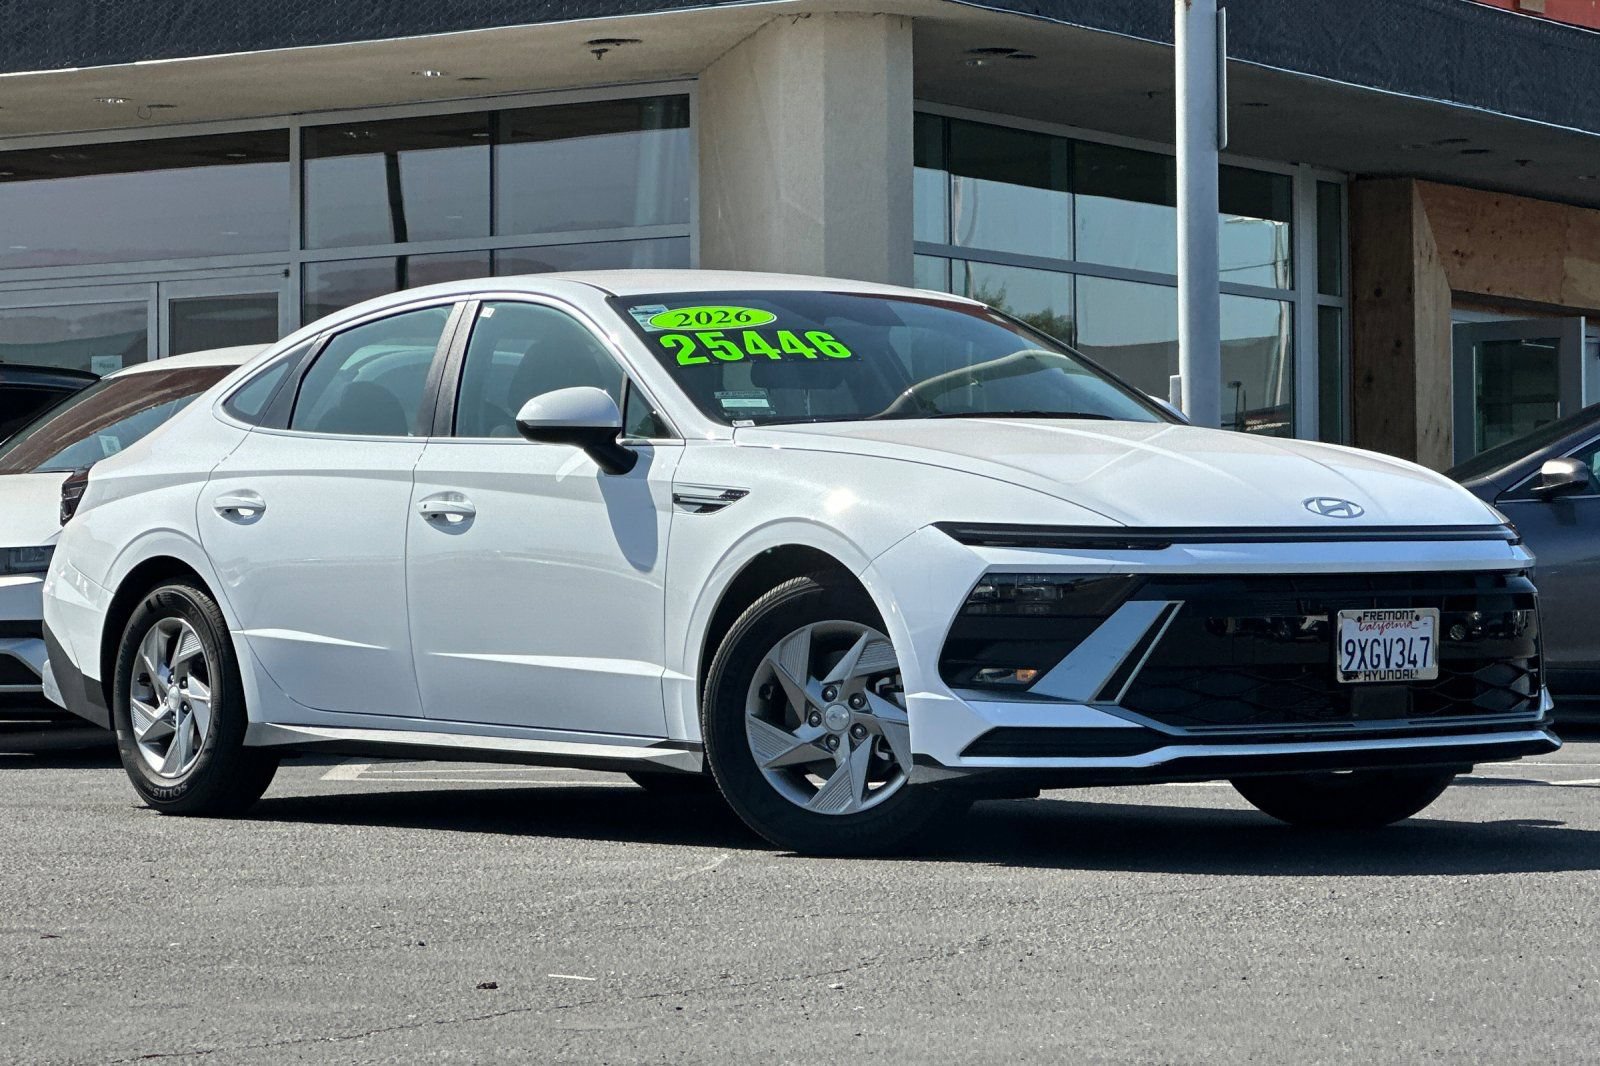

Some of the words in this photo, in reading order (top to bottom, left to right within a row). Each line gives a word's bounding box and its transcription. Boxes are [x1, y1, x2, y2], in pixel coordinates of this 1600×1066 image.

[674, 309, 752, 328] 2026
[659, 330, 852, 366] 25446
[1362, 610, 1416, 621] FREMONT
[1359, 620, 1419, 636] California
[1344, 636, 1430, 670] 9XGV347
[1363, 669, 1414, 680] HYUNDAI
[152, 782, 188, 798] SOLUS
